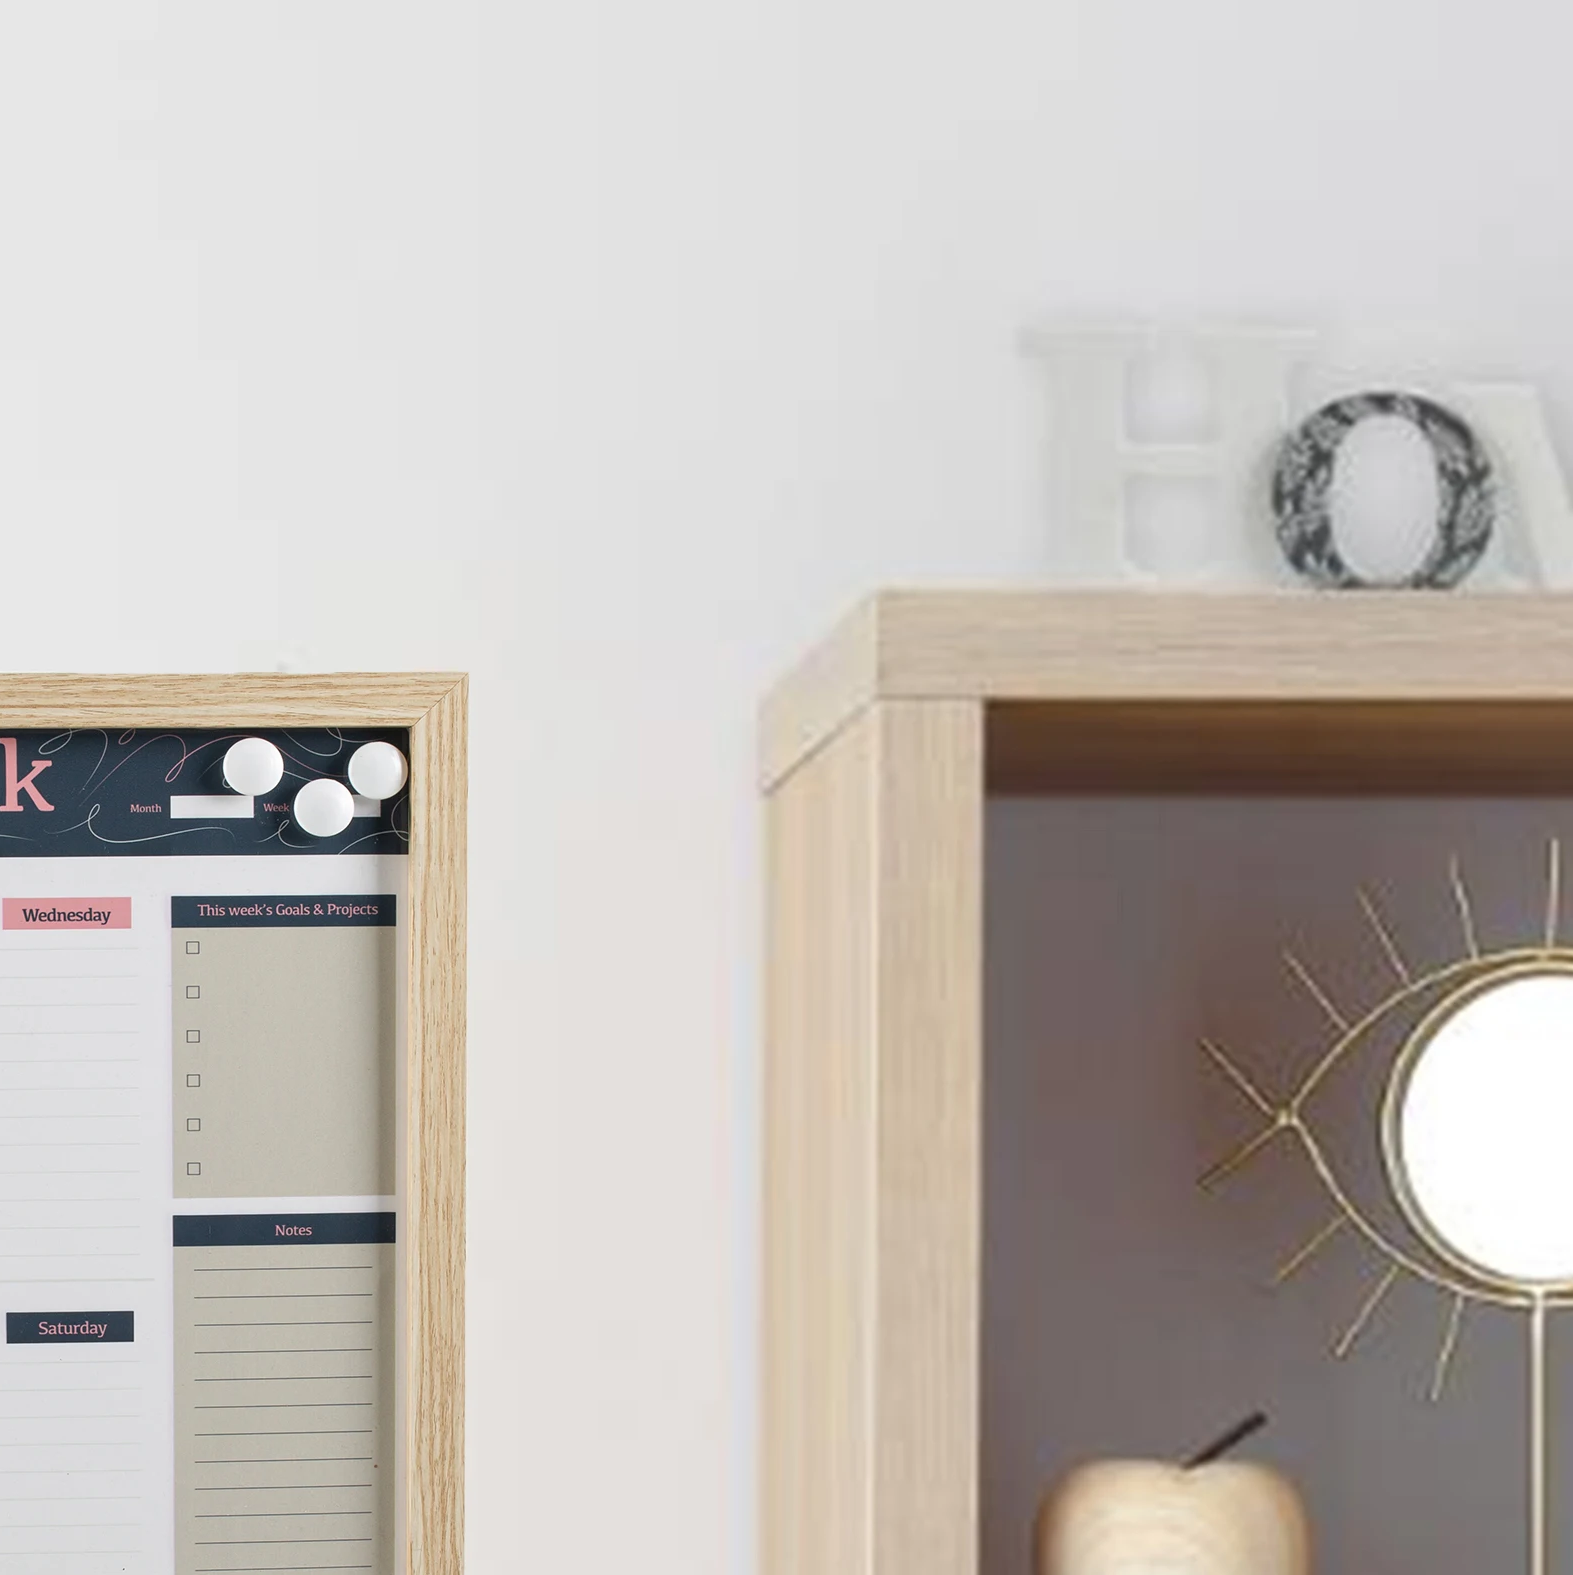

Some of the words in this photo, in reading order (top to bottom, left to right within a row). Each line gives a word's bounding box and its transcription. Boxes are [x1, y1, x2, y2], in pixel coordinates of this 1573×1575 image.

[130, 803, 162, 814] Month
[263, 802, 290, 813] Week
[22, 907, 111, 925] Wednesday
[197, 904, 226, 917] This
[228, 904, 273, 916] week’s
[275, 904, 311, 916] Goals
[313, 904, 324, 916] &
[327, 902, 379, 918] Projects
[275, 1224, 313, 1237] Notes
[38, 1321, 108, 1338] Saturday
